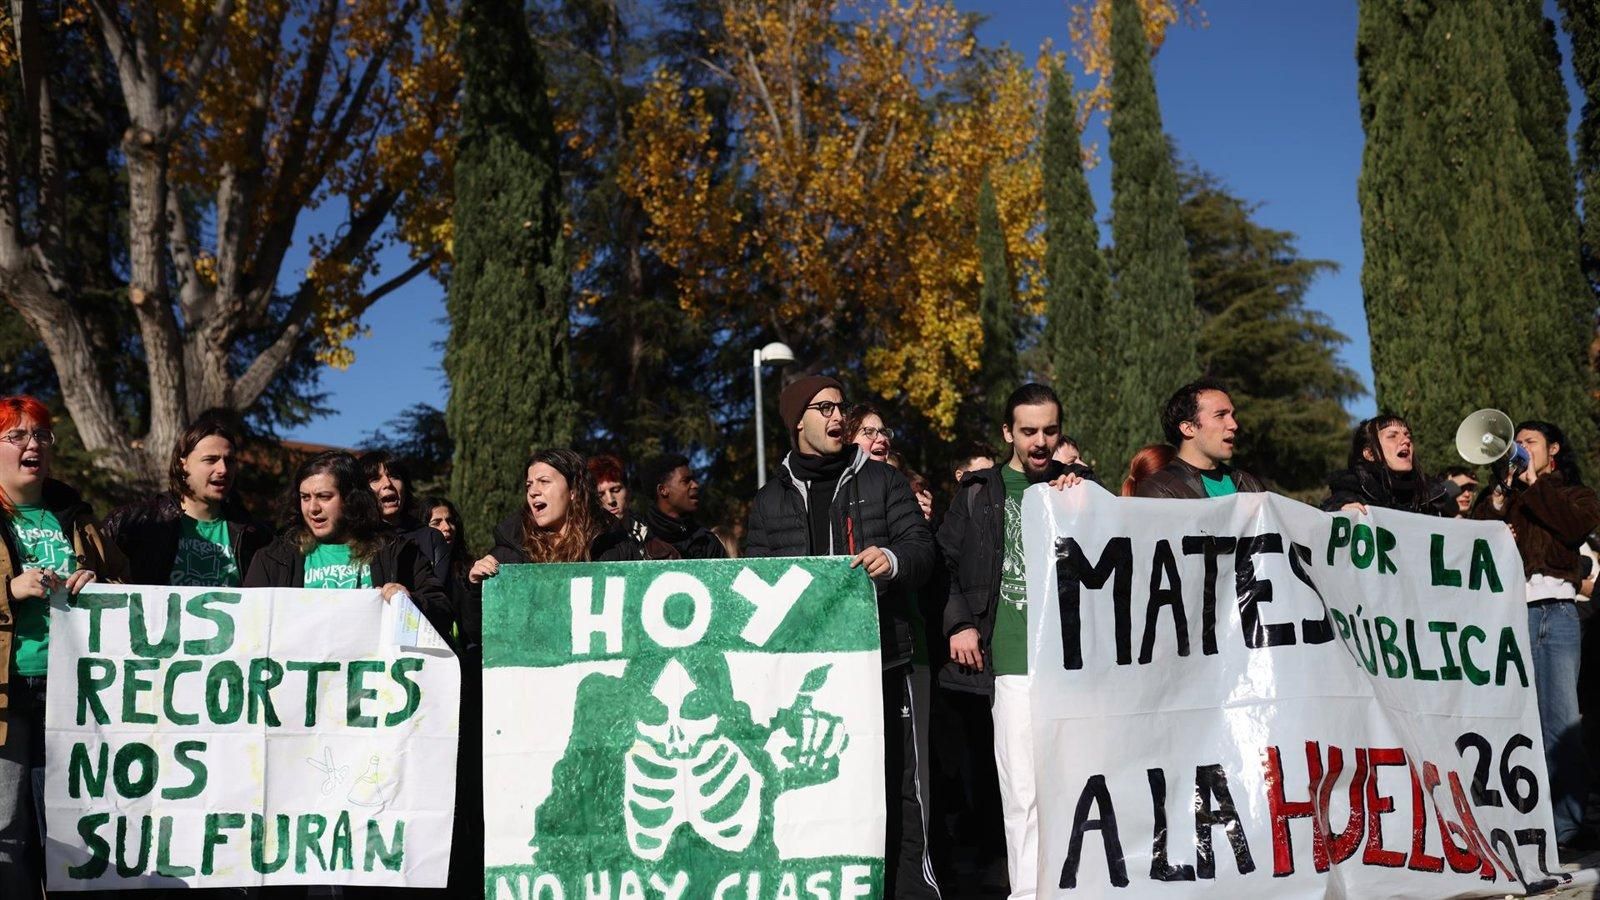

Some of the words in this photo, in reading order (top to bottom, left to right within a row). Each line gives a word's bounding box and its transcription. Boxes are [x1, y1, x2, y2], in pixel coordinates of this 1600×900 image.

[1327, 516, 1398, 575] POR
[1430, 533, 1504, 593] LA
[69, 592, 242, 658] TUS
[570, 563, 815, 655] HOY
[1055, 531, 1335, 671] MATES
[1330, 604, 1529, 688] PÚBLICA
[76, 657, 425, 728] RECORTES
[68, 740, 208, 800] NOS
[1455, 731, 1539, 815] 26
[68, 809, 405, 880] SULFURAN
[1059, 774, 1130, 889] A
[1147, 763, 1256, 882] LA
[1263, 740, 1517, 884] HUELGA
[585, 869, 690, 900] HAY
